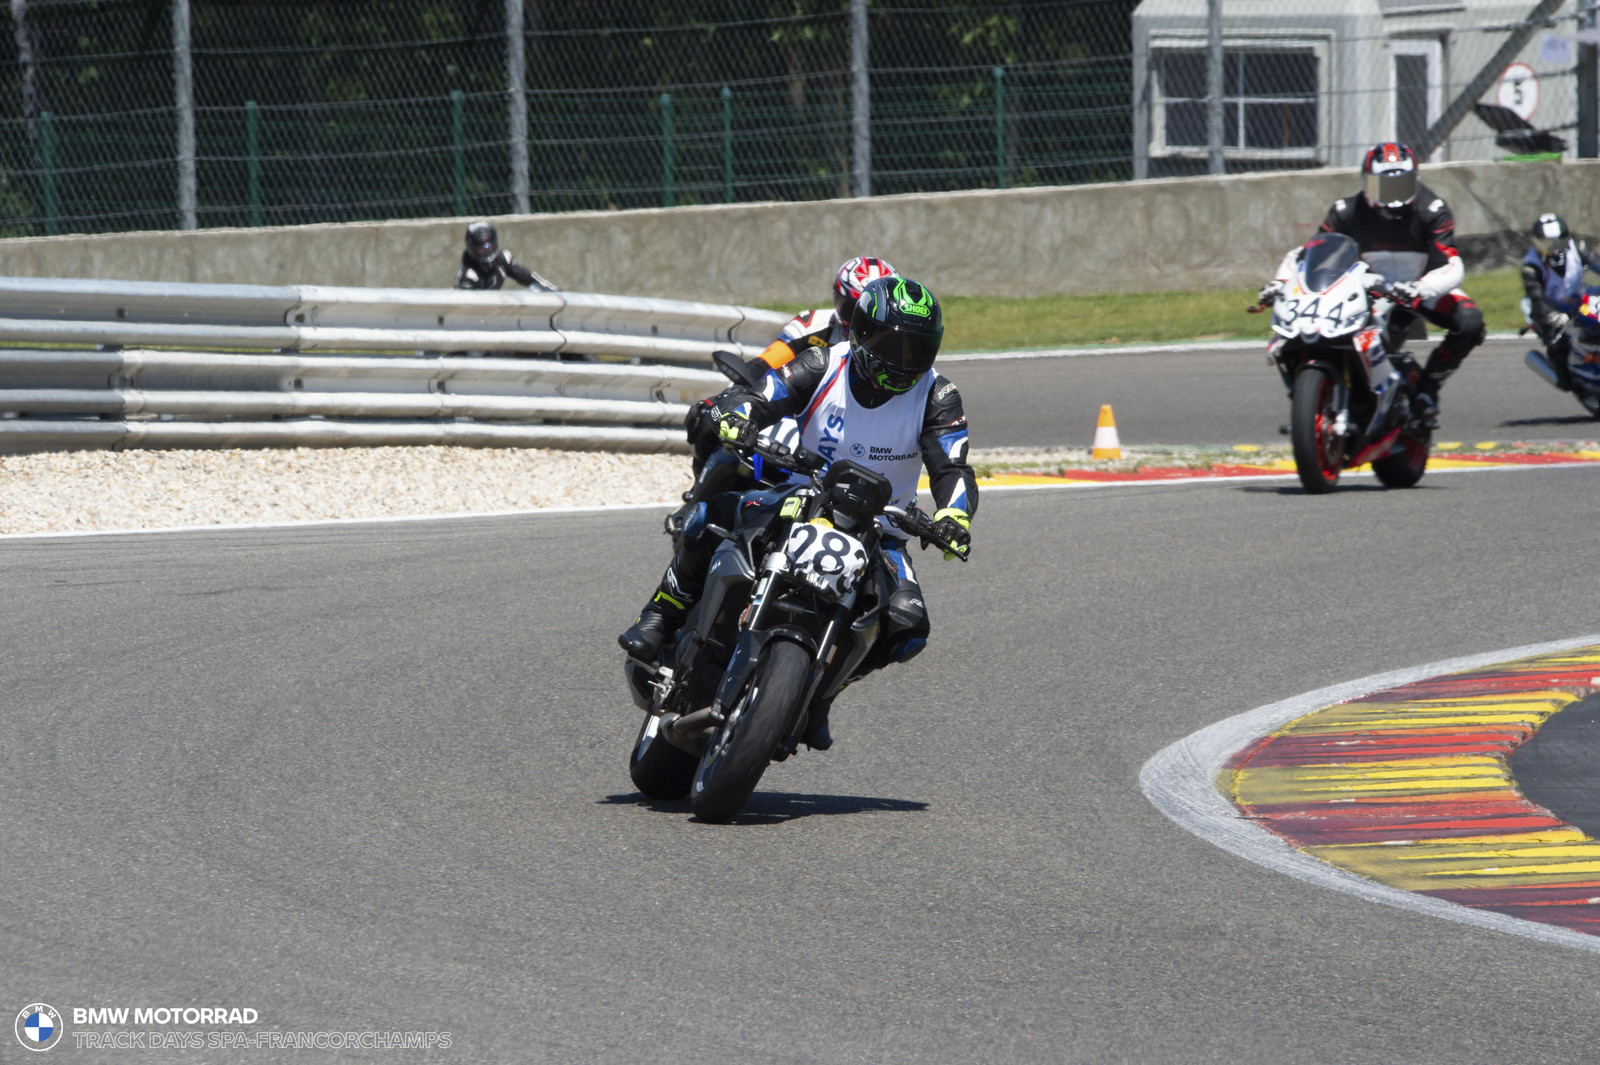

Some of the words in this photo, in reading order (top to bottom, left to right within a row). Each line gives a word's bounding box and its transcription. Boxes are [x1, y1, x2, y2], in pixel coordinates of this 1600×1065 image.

[904, 305, 928, 316] SHOEI
[1284, 297, 1344, 329] 344
[870, 446, 893, 455] BMW
[869, 452, 918, 461] MOTORRAD
